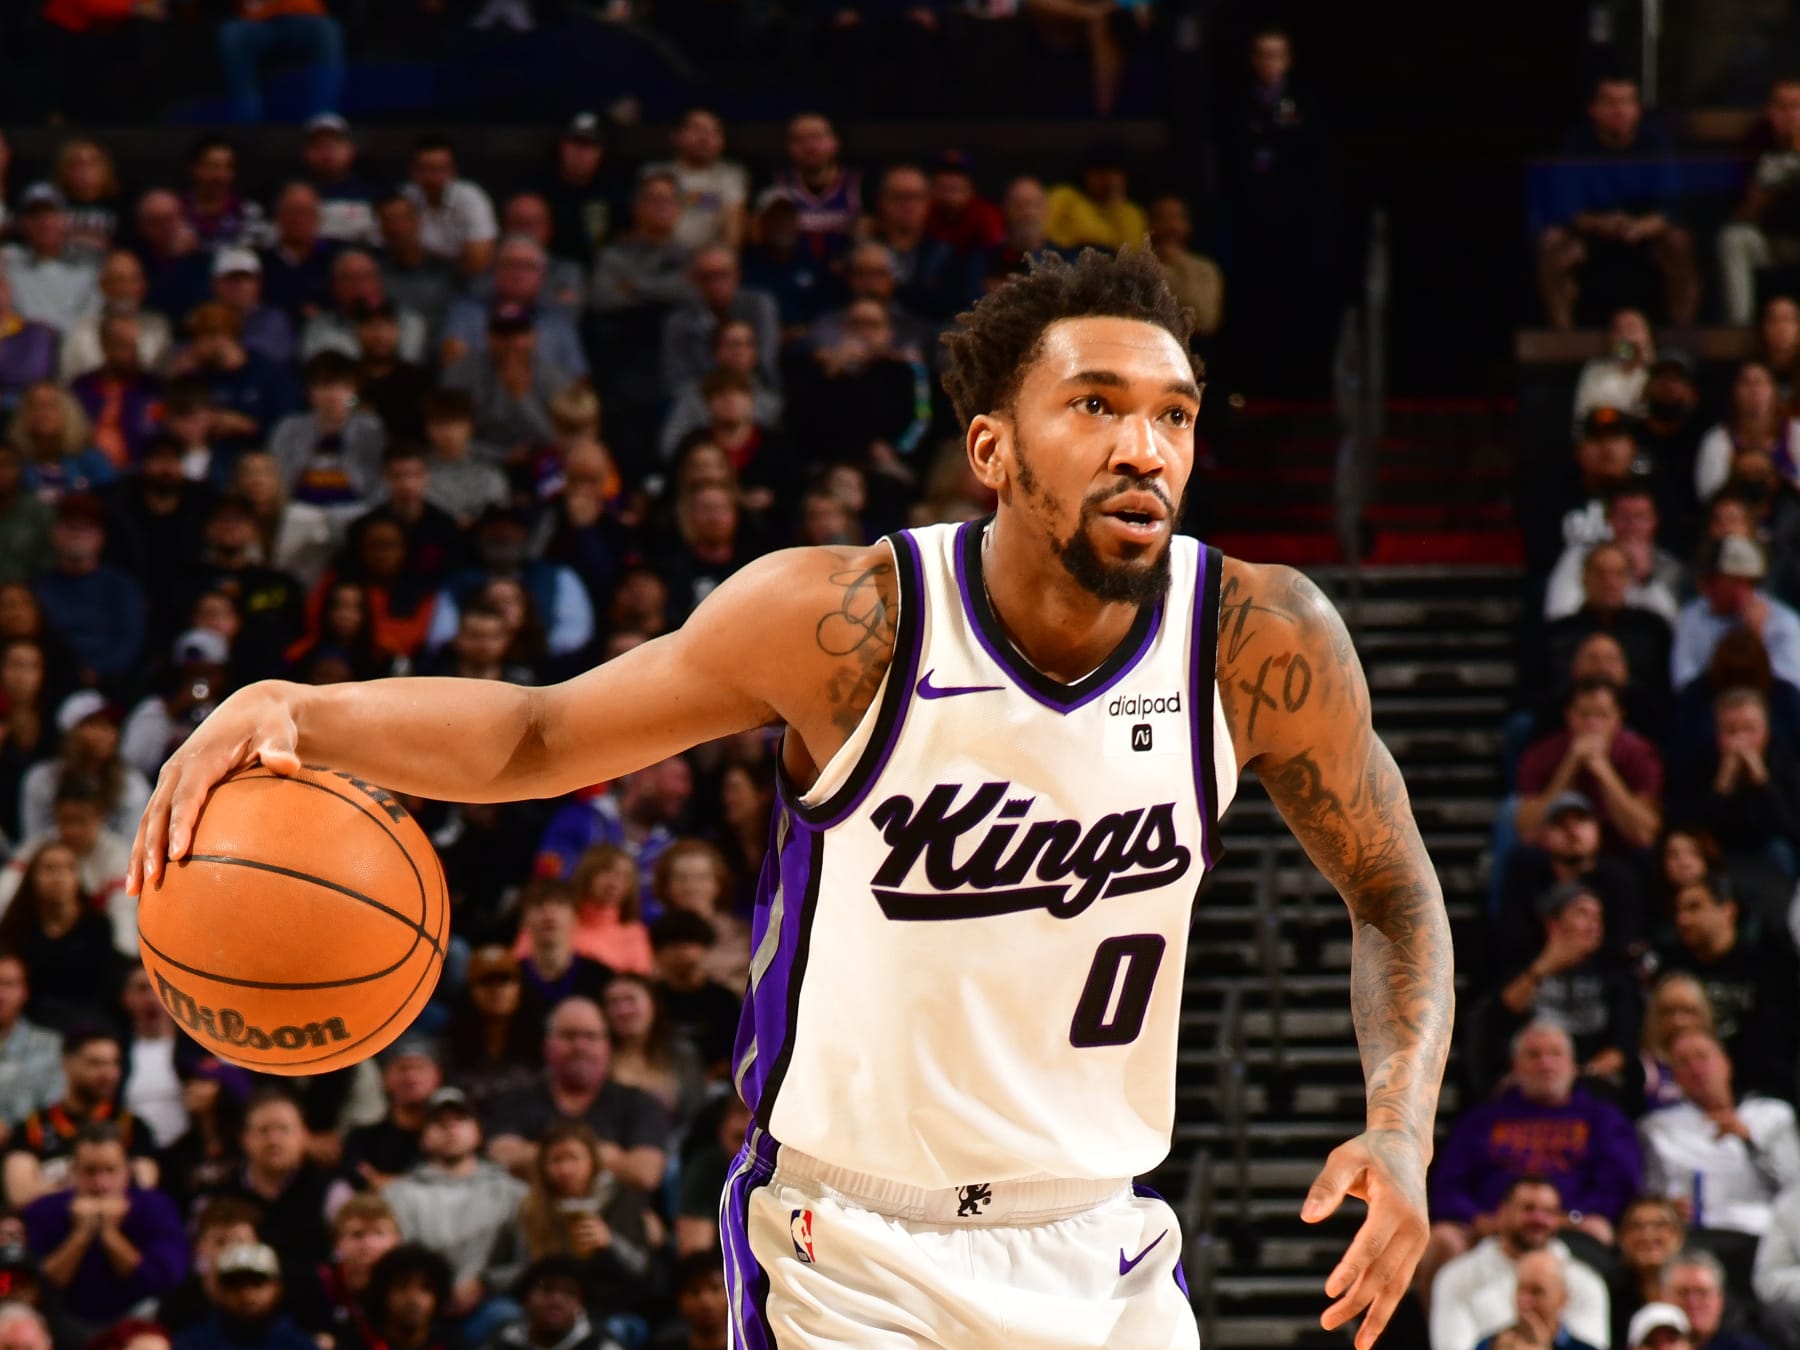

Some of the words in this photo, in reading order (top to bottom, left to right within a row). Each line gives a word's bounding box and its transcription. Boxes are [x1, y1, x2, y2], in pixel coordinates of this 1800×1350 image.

[1109, 691, 1181, 720] dialpad
[870, 781, 1191, 921] Kings
[153, 967, 351, 1050] Wilson
[1069, 933, 1166, 1048] 0
